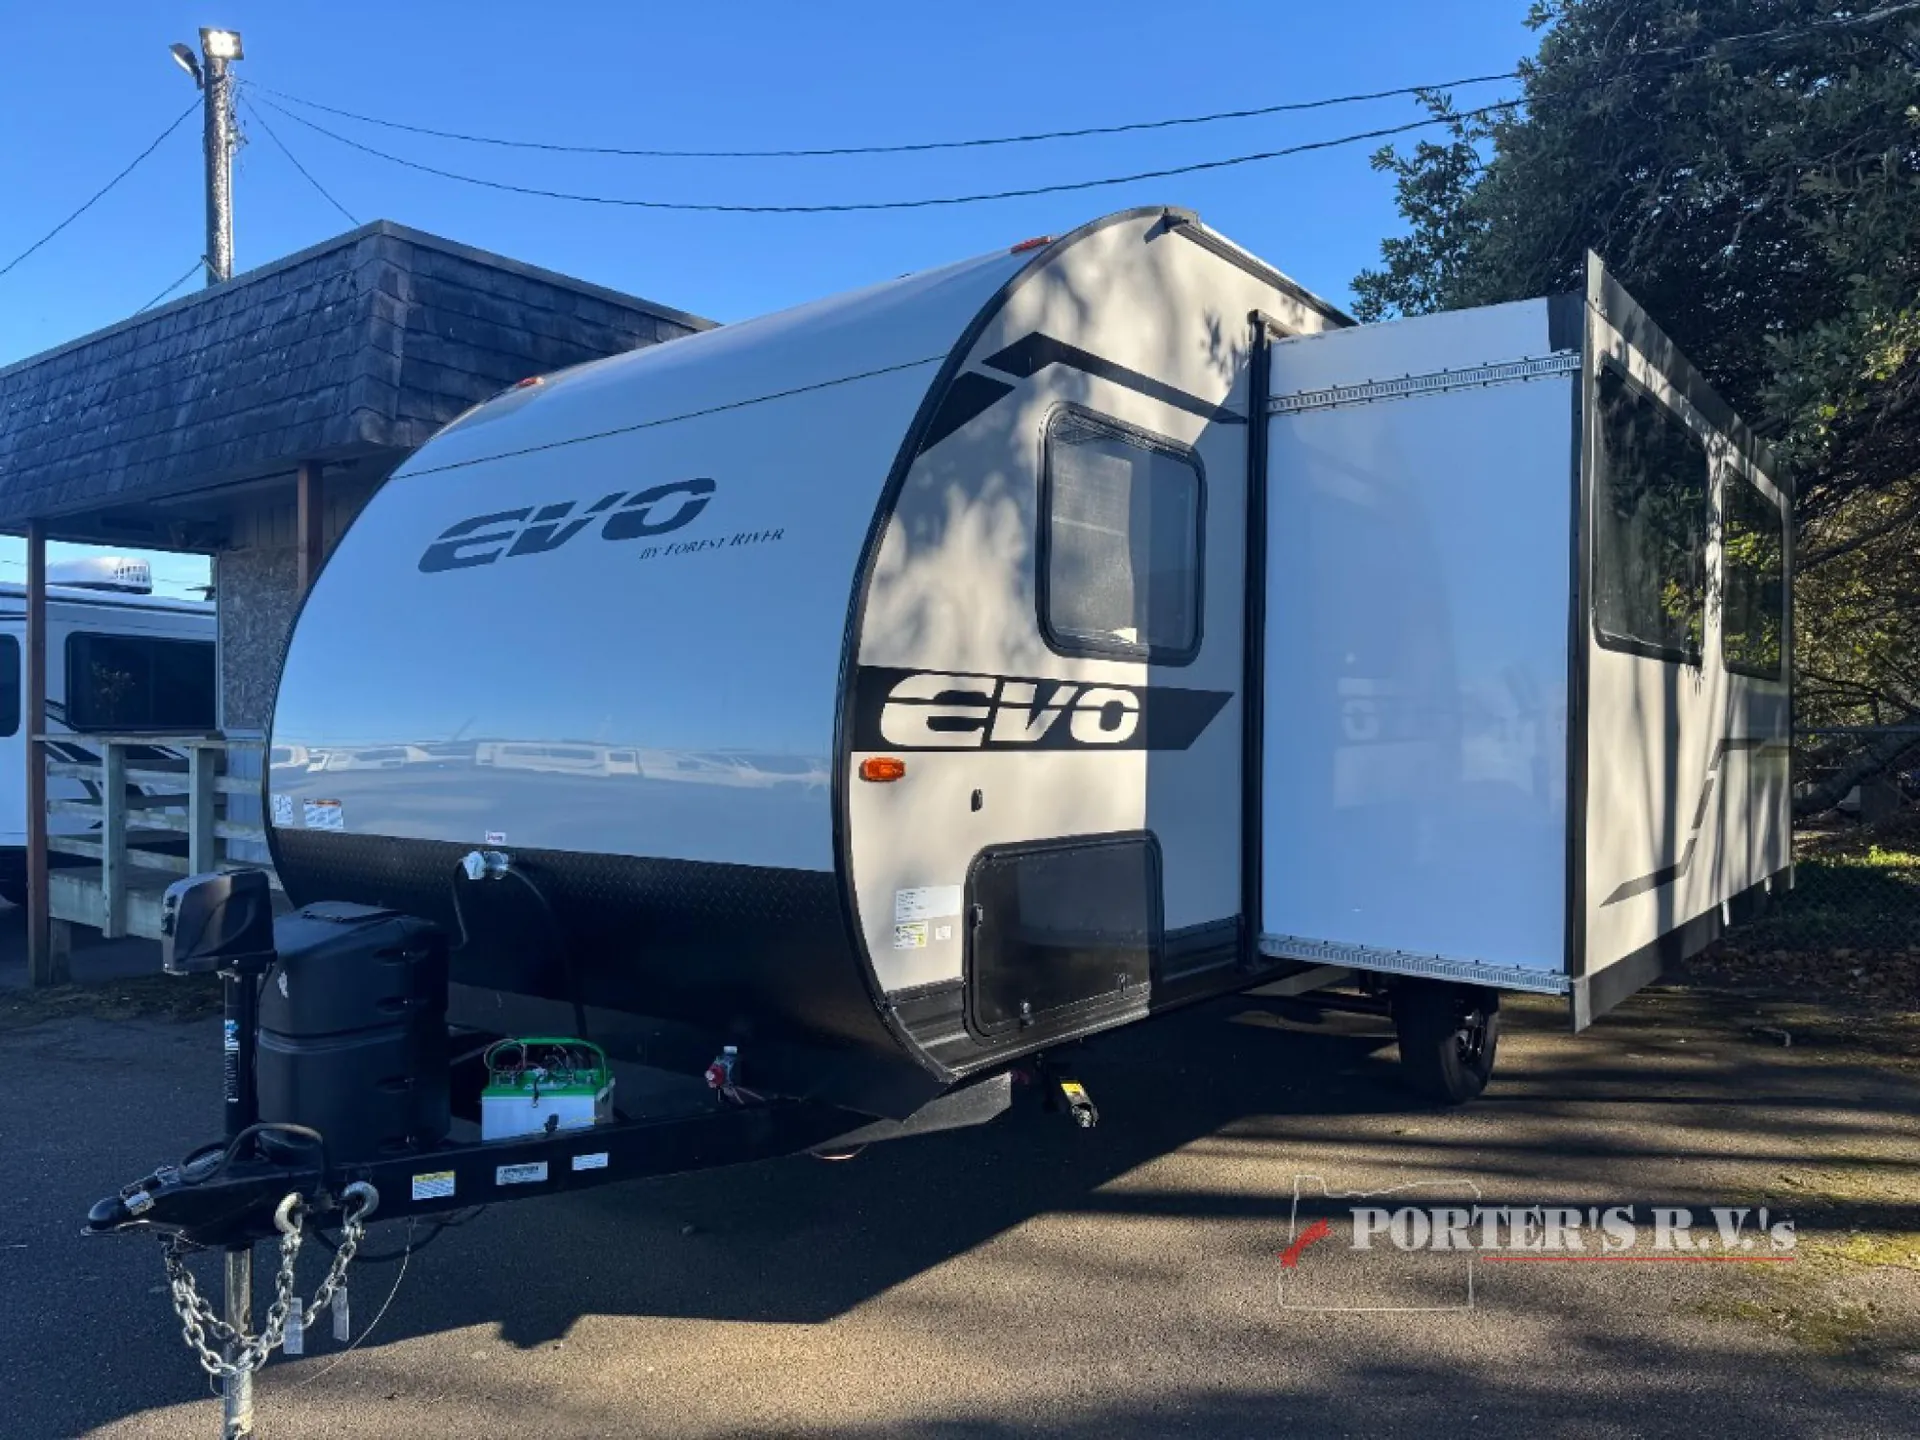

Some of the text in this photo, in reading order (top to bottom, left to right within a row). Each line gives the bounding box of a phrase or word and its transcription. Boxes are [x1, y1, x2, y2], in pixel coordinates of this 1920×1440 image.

[418, 477, 716, 573] EVO
[639, 527, 785, 560] BY FOREST RIVER
[880, 673, 1140, 747] EVO
